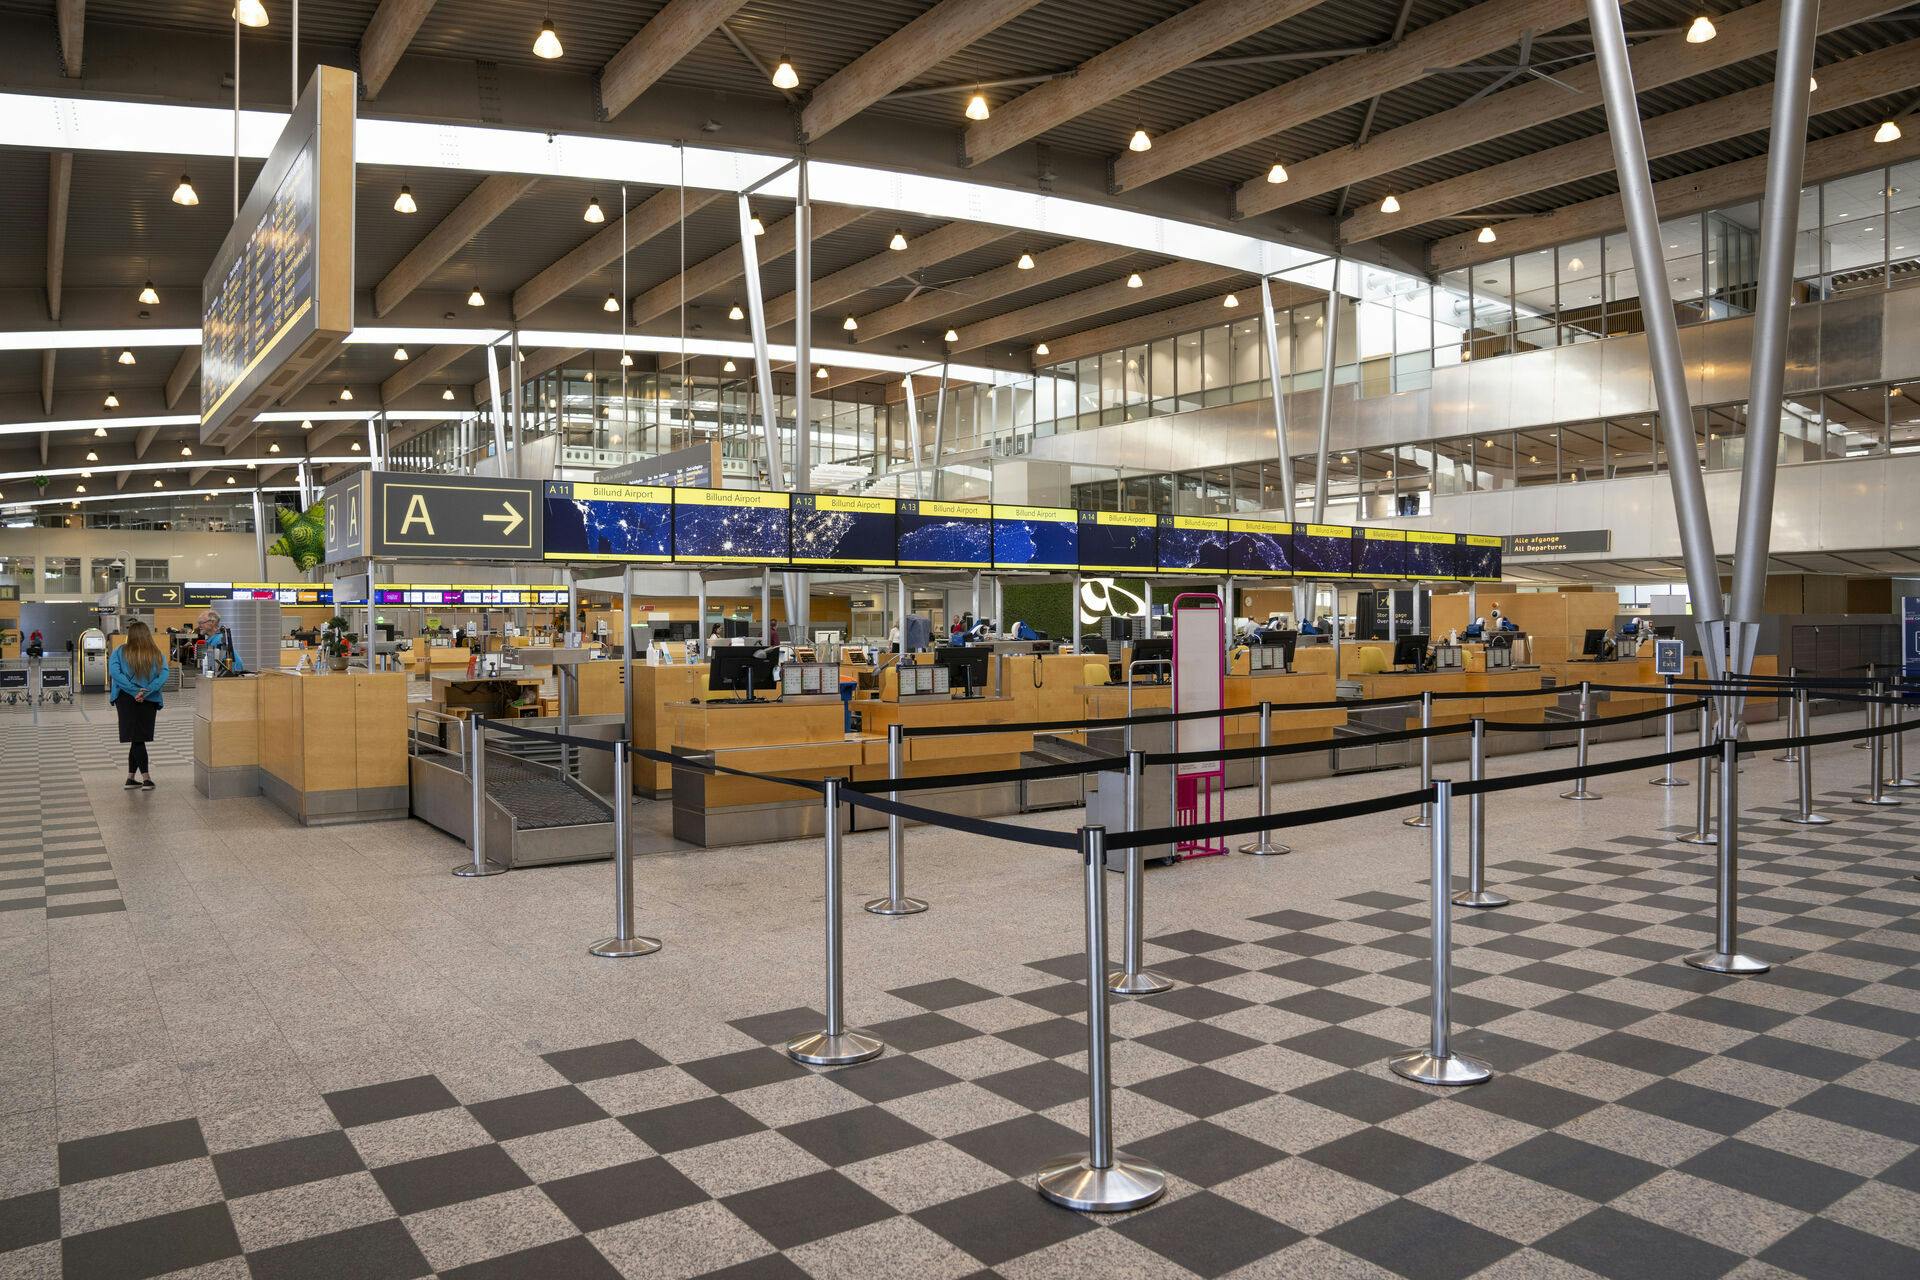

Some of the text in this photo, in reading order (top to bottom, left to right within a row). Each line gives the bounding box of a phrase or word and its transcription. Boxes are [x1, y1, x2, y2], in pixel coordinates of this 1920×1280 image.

[550, 486, 569, 494] A 11
[593, 488, 653, 499] Billund Airport
[706, 493, 761, 504] Billund Airport
[832, 500, 881, 510] Billund Airport
[934, 505, 978, 515] Billund Airport
[349, 496, 357, 537] A
[400, 494, 435, 535] A
[1016, 509, 1056, 519] Billund Airport
[329, 504, 335, 542] B
[1127, 516, 1146, 524] Airport
[1527, 544, 1566, 552] Departures
[135, 588, 146, 601] C
